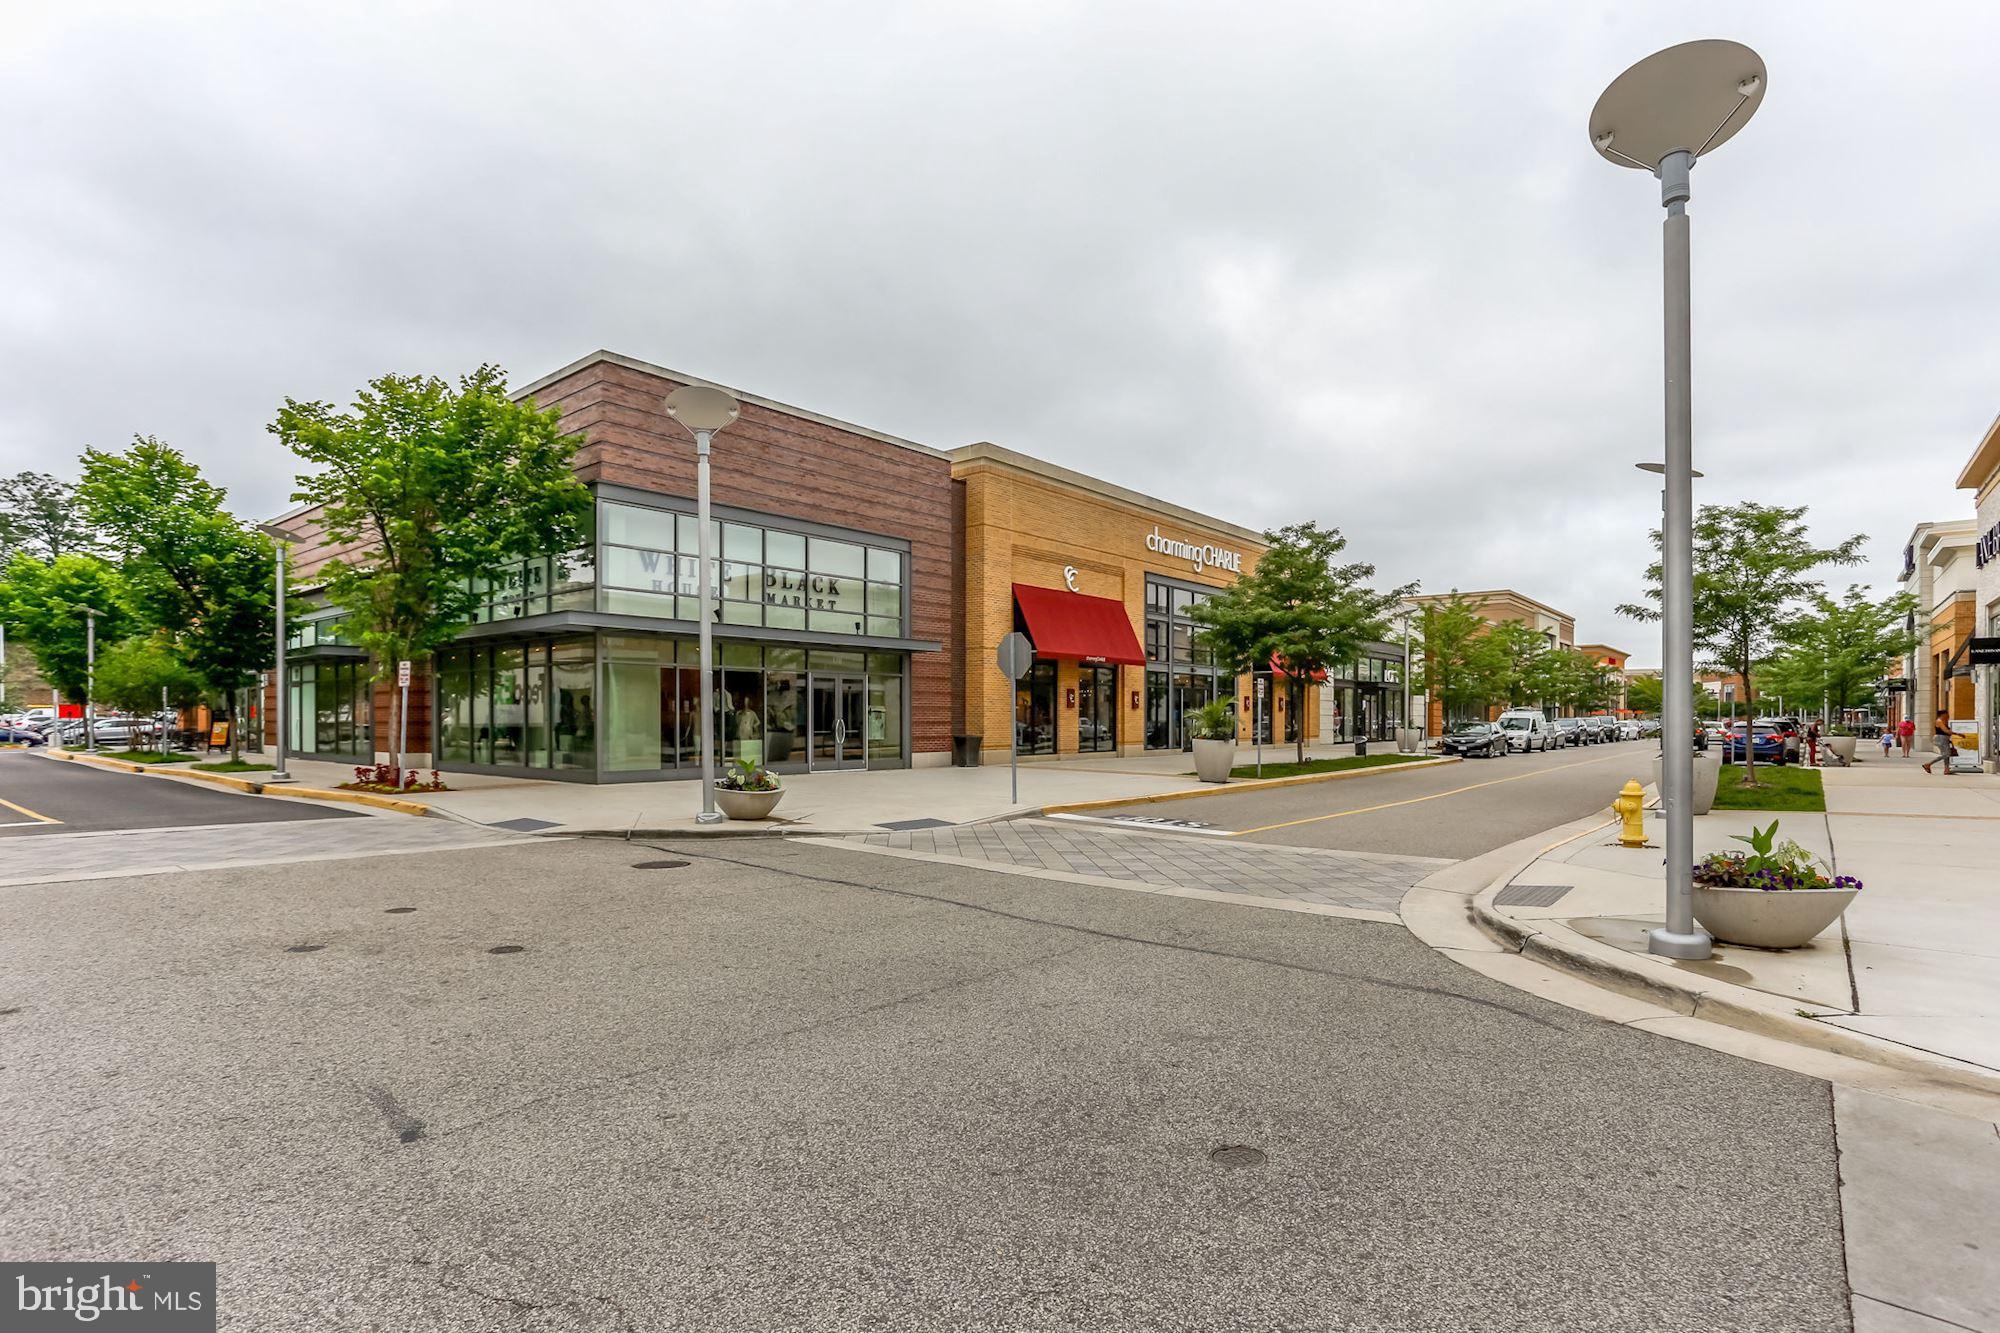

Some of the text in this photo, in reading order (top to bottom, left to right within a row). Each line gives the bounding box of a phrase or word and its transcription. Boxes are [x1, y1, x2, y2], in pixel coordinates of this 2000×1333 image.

[638, 550, 841, 596] WHIE BLACK
[766, 592, 837, 610] MARKET
